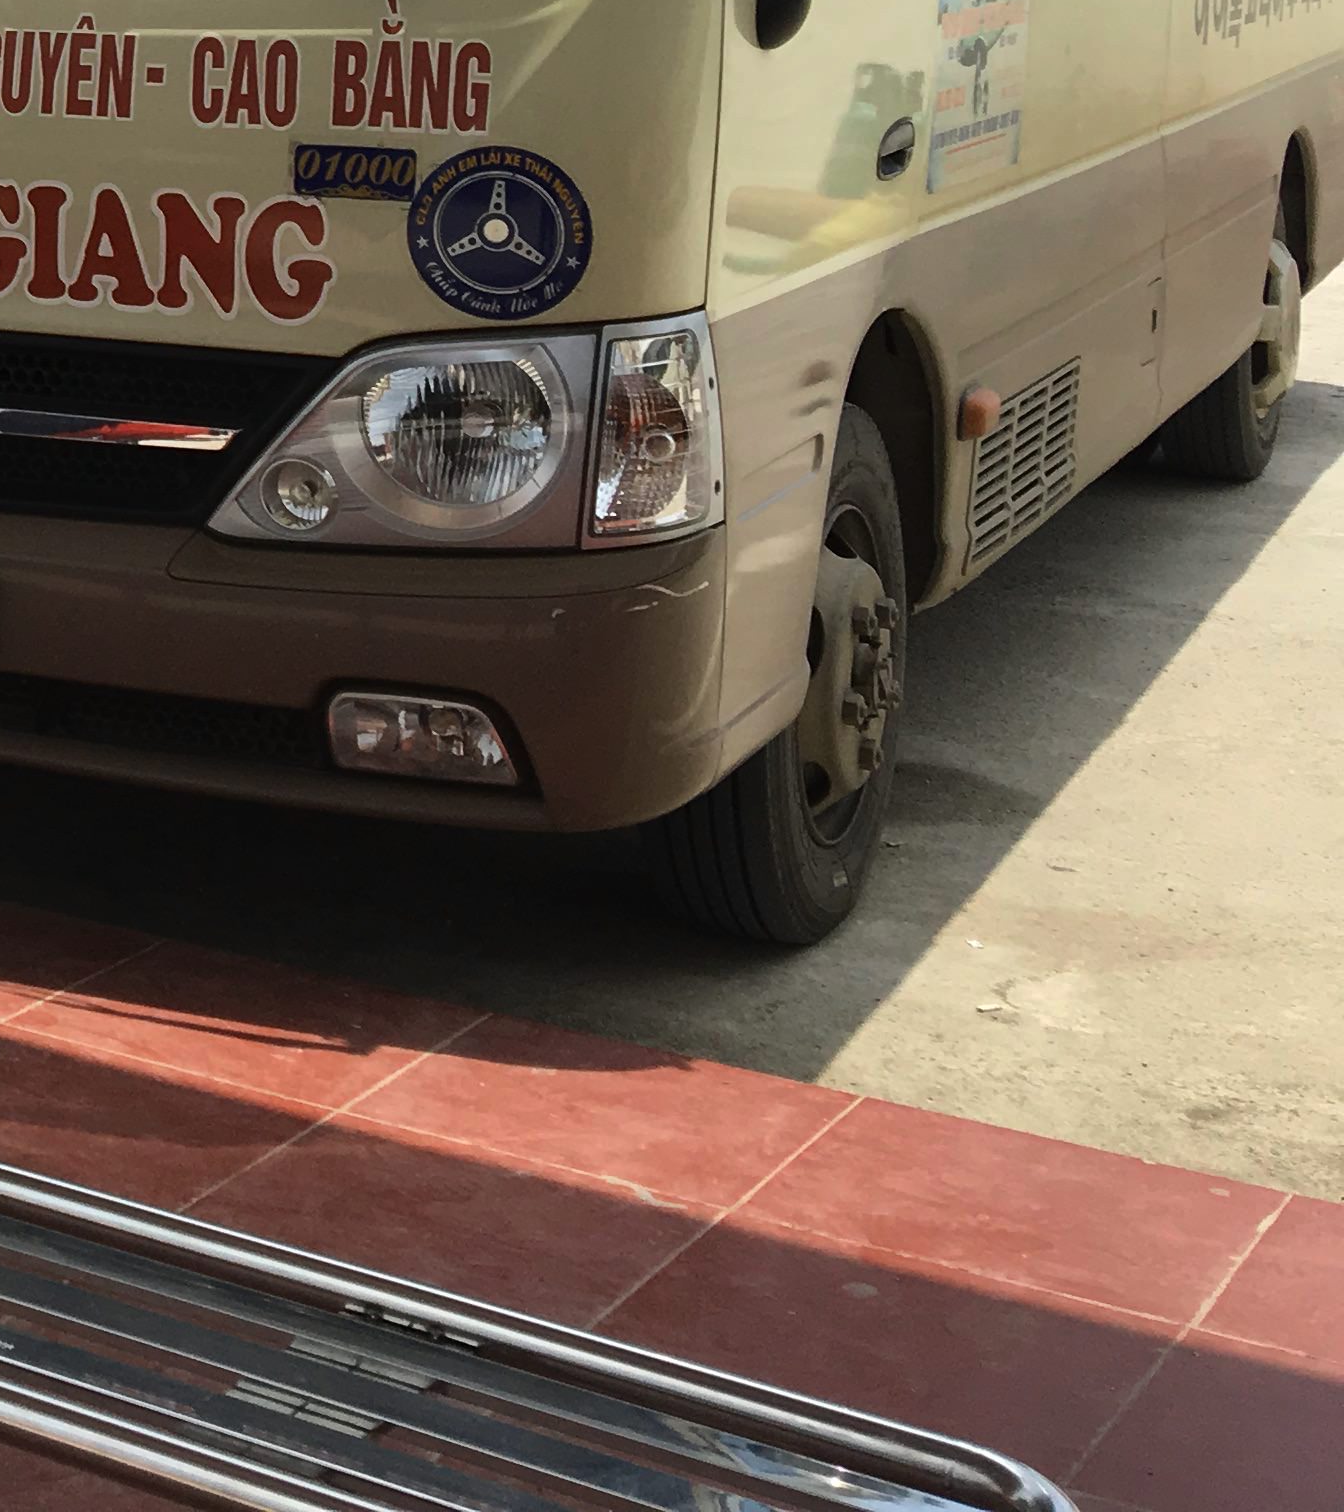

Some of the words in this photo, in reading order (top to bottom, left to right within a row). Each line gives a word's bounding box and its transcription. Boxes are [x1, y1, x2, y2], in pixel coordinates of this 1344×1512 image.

[191, 32, 300, 131] CAO
[297, 149, 415, 186] 01000
[432, 167, 457, 196] ANH
[458, 156, 478, 172] EM
[503, 152, 521, 167] XE
[525, 157, 554, 184] THÁI
